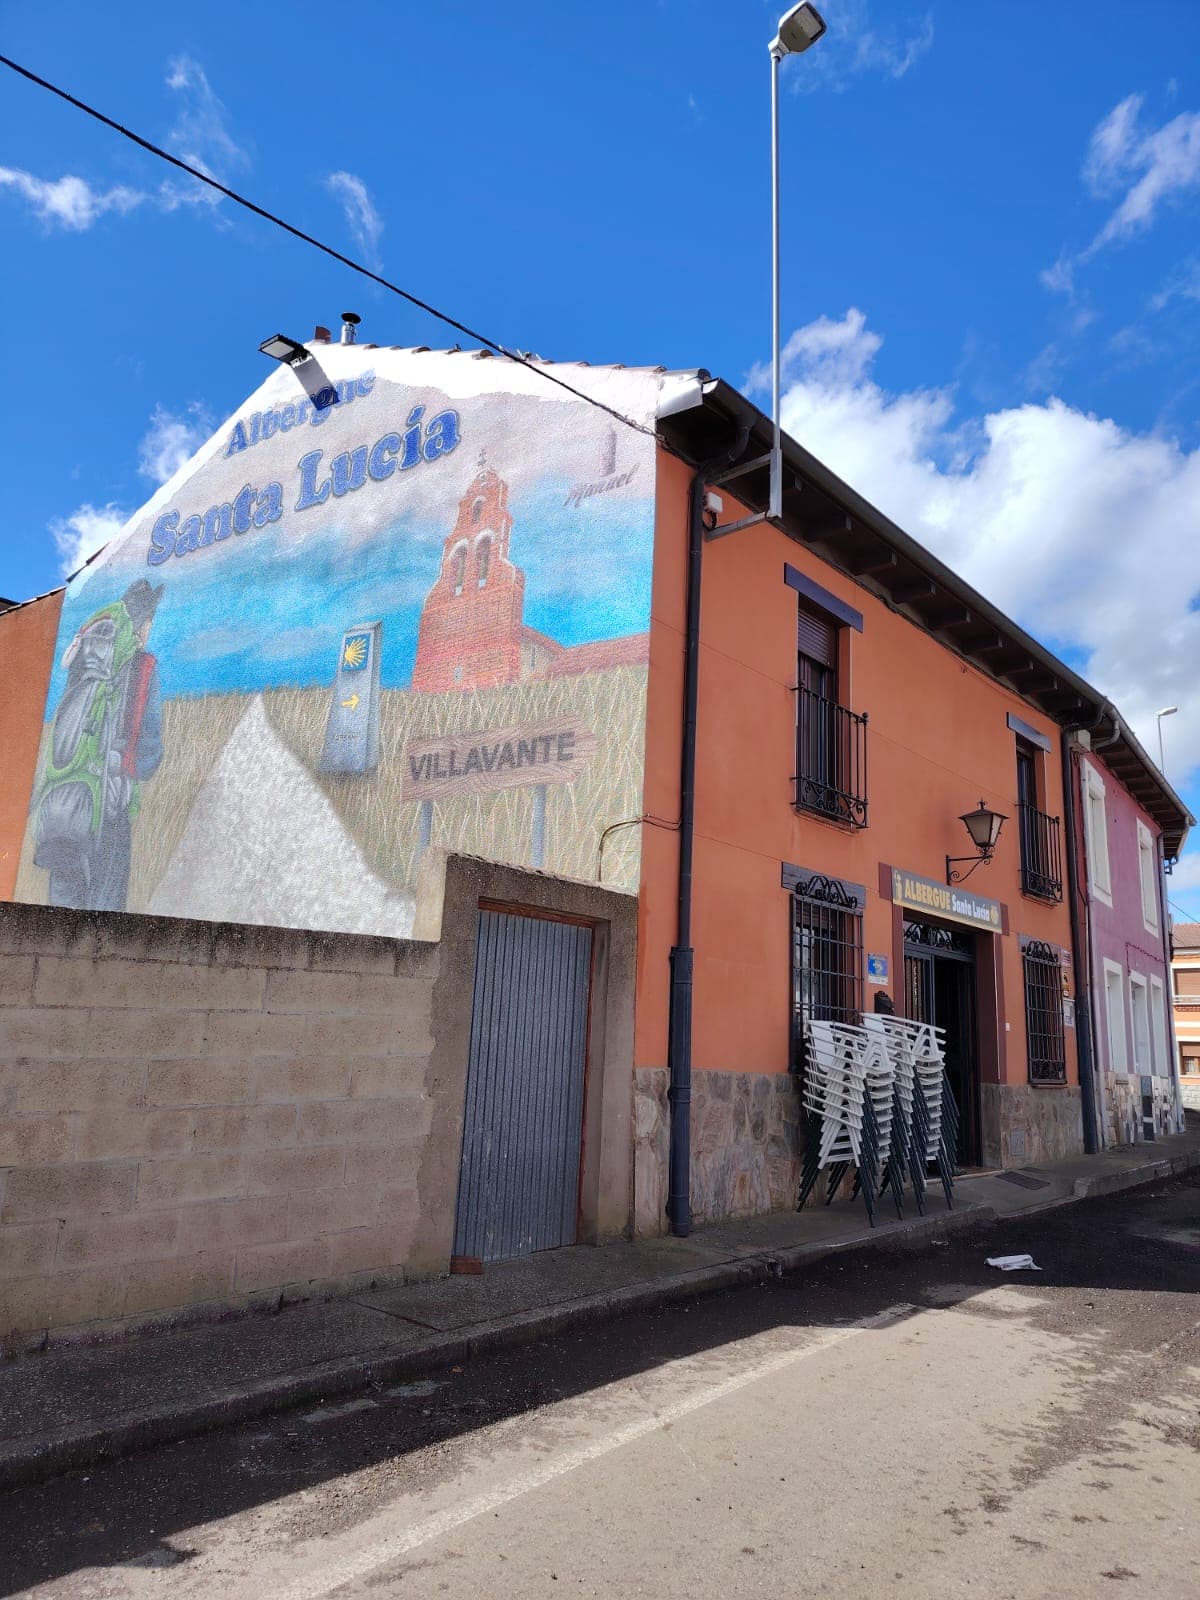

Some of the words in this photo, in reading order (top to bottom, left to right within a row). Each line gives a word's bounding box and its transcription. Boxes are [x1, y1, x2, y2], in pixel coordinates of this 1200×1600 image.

[147, 482, 283, 566] Santa
[294, 405, 461, 511] Lucía
[409, 731, 576, 781] VILLAVANTE
[905, 878, 951, 909] ALBERGUE
[952, 894, 972, 916] Santa
[973, 900, 990, 921] Lucía
